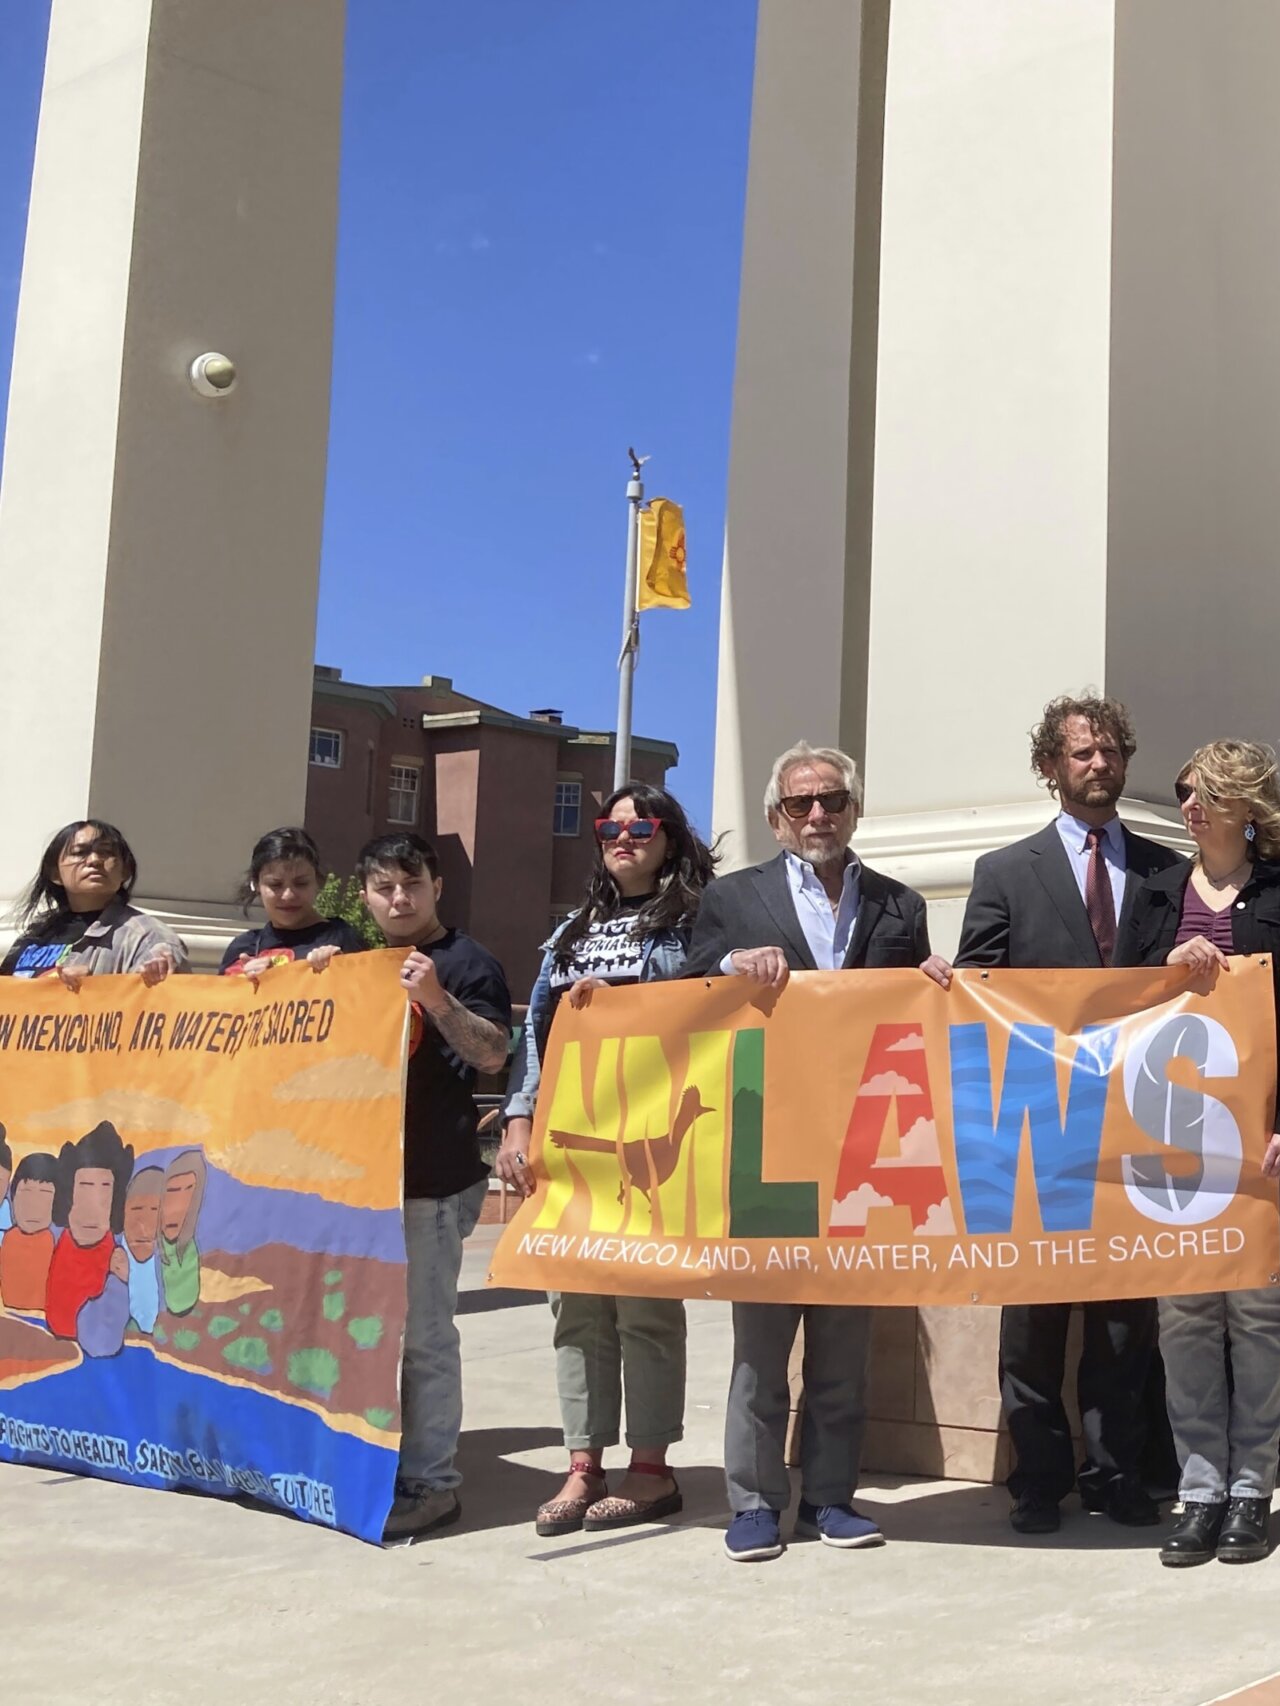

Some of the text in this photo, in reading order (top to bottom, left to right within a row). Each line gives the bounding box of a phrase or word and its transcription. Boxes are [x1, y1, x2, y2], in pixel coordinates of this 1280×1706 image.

[17, 1013, 89, 1053] MEXICO
[129, 1010, 166, 1057] AIR,
[262, 998, 335, 1046] SACRED
[516, 1226, 1246, 1274] NEW MEXICO LAND, AIR, WATER, AND THE SACRED
[50, 1429, 71, 1454] TO
[73, 1434, 134, 1473] HEALTH,
